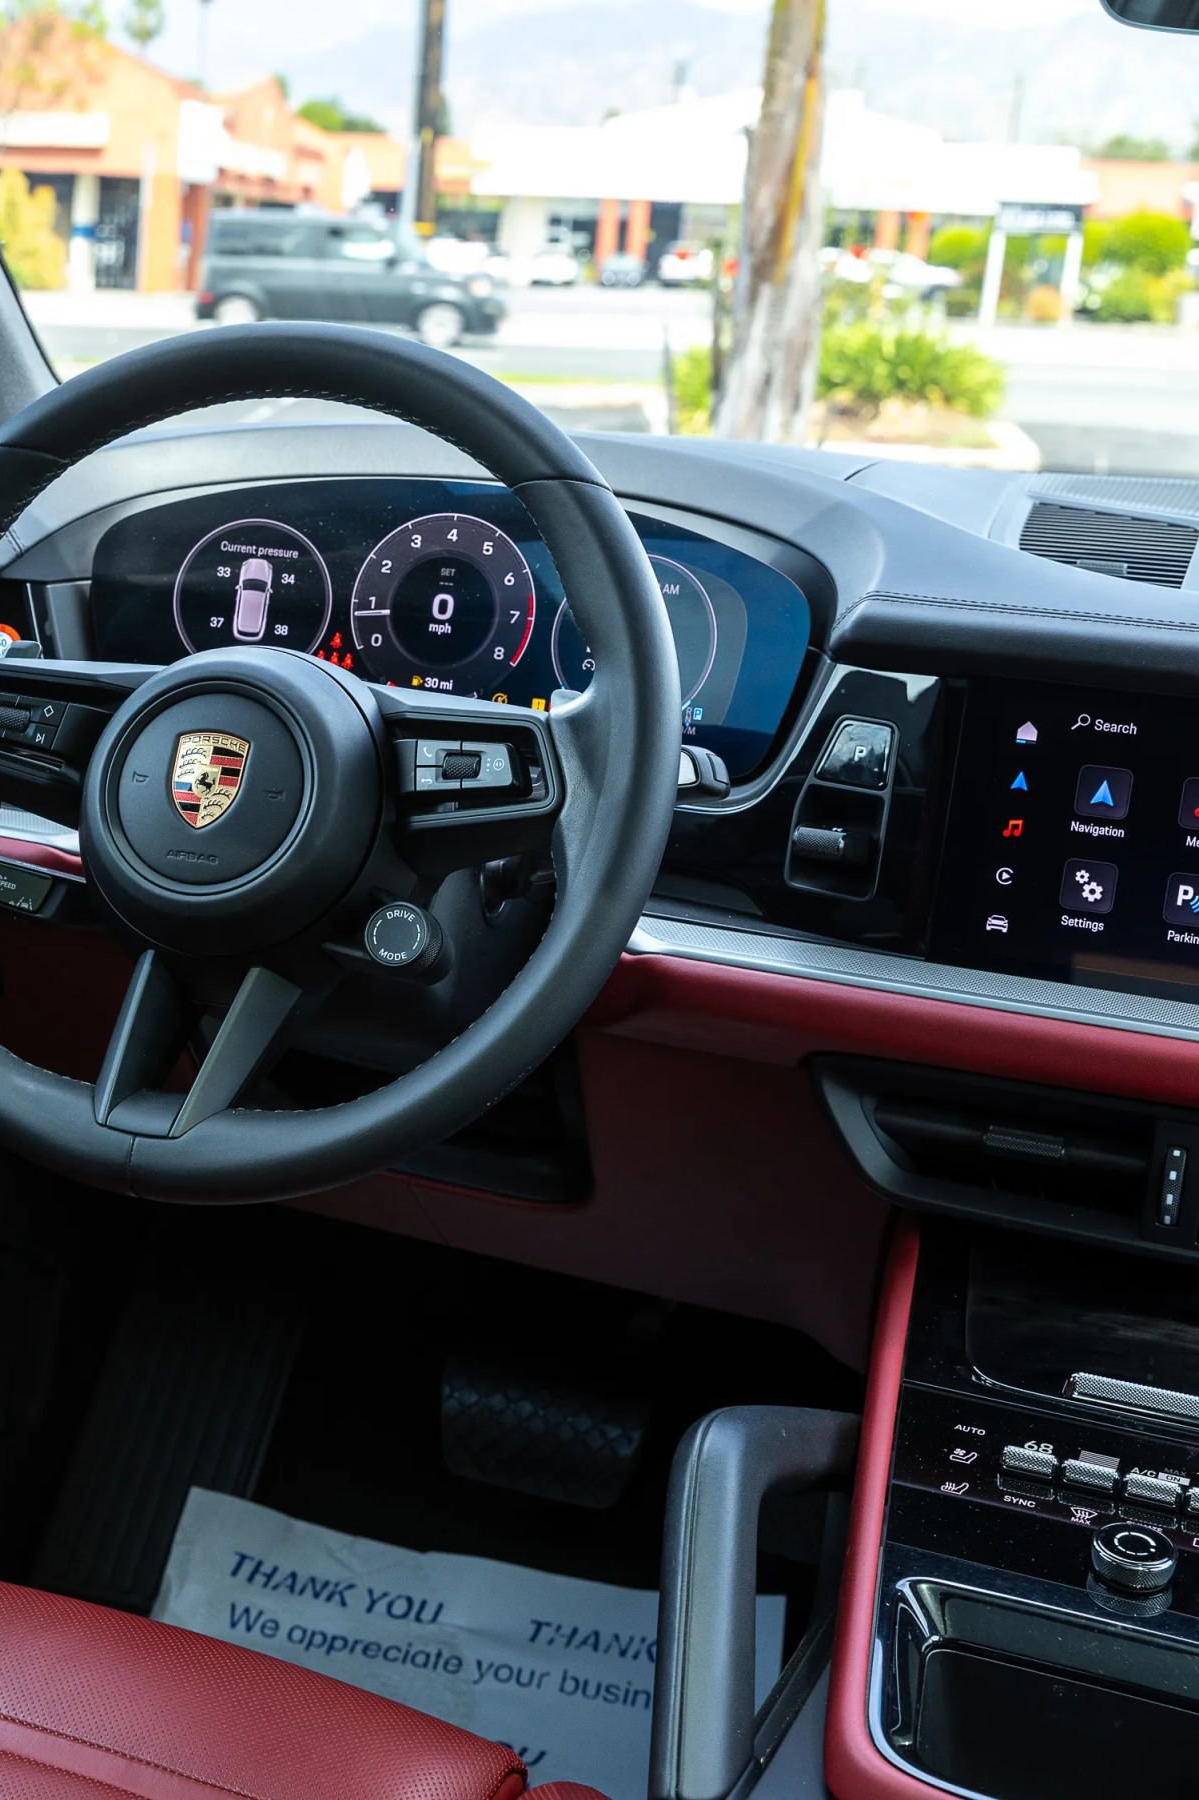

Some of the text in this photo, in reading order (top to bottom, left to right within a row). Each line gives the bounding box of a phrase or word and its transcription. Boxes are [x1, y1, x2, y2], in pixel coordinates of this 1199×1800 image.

[410, 534, 422, 548] 3
[447, 528, 458, 542] 4
[220, 540, 299, 559] Current pressure
[482, 541, 494, 555] 5
[216, 566, 231, 577] 33
[380, 559, 393, 574] 2
[440, 567, 456, 576] SET
[281, 573, 295, 585] 34
[503, 572, 515, 586] 6
[662, 584, 680, 595] AM
[368, 596, 376, 609] 1
[431, 593, 455, 621] 0
[209, 616, 224, 628] 37
[509, 610, 520, 624] 7
[274, 624, 289, 636] 38
[428, 622, 452, 635] mph
[370, 633, 383, 647] 0
[493, 646, 505, 660] 8
[424, 677, 454, 691] 30 mi
[1094, 719, 1138, 736] Search
[182, 735, 249, 754] PORSCHE
[854, 746, 868, 762] P
[1070, 821, 1125, 838] Navigation
[166, 850, 219, 865] AIRBAG
[386, 909, 416, 923] DRIVE
[1060, 915, 1105, 932] Settings
[378, 948, 408, 961] MODE
[954, 1424, 986, 1436] AUTO
[1023, 1440, 1054, 1455] 68
[1130, 1467, 1187, 1478] A/C MAX
[1003, 1495, 1036, 1508] SYNC
[1071, 1517, 1091, 1526] MAX
[228, 1551, 445, 1625] THANK YOU
[228, 1601, 280, 1639] We
[287, 1620, 463, 1676] appreciate
[473, 1657, 551, 1690] your
